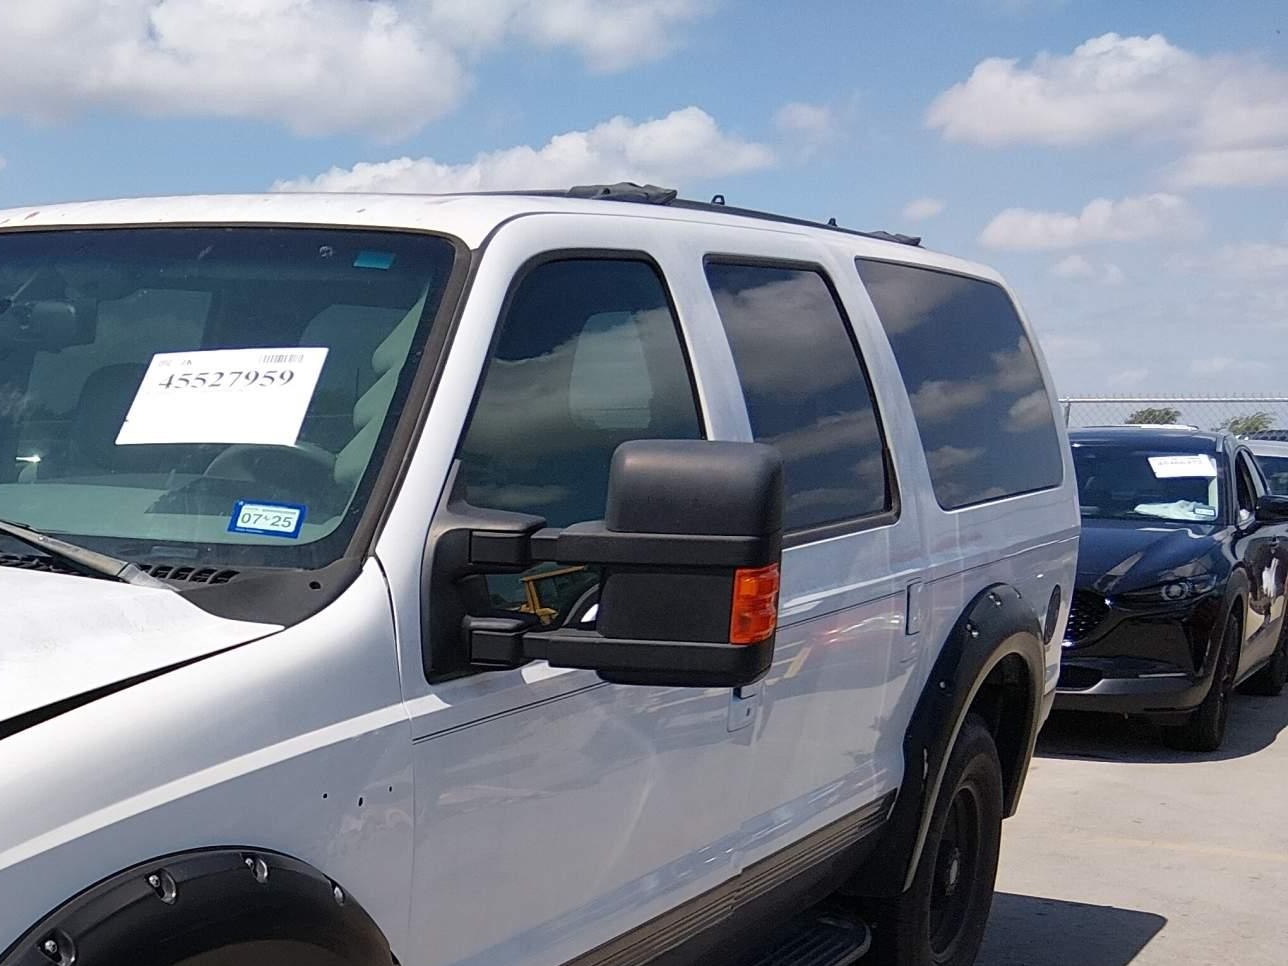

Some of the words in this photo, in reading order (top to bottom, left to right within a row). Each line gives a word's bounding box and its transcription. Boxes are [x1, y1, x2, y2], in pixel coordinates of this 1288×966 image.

[158, 370, 294, 389] 45527959
[241, 512, 263, 525] 07
[270, 515, 293, 528] 25
